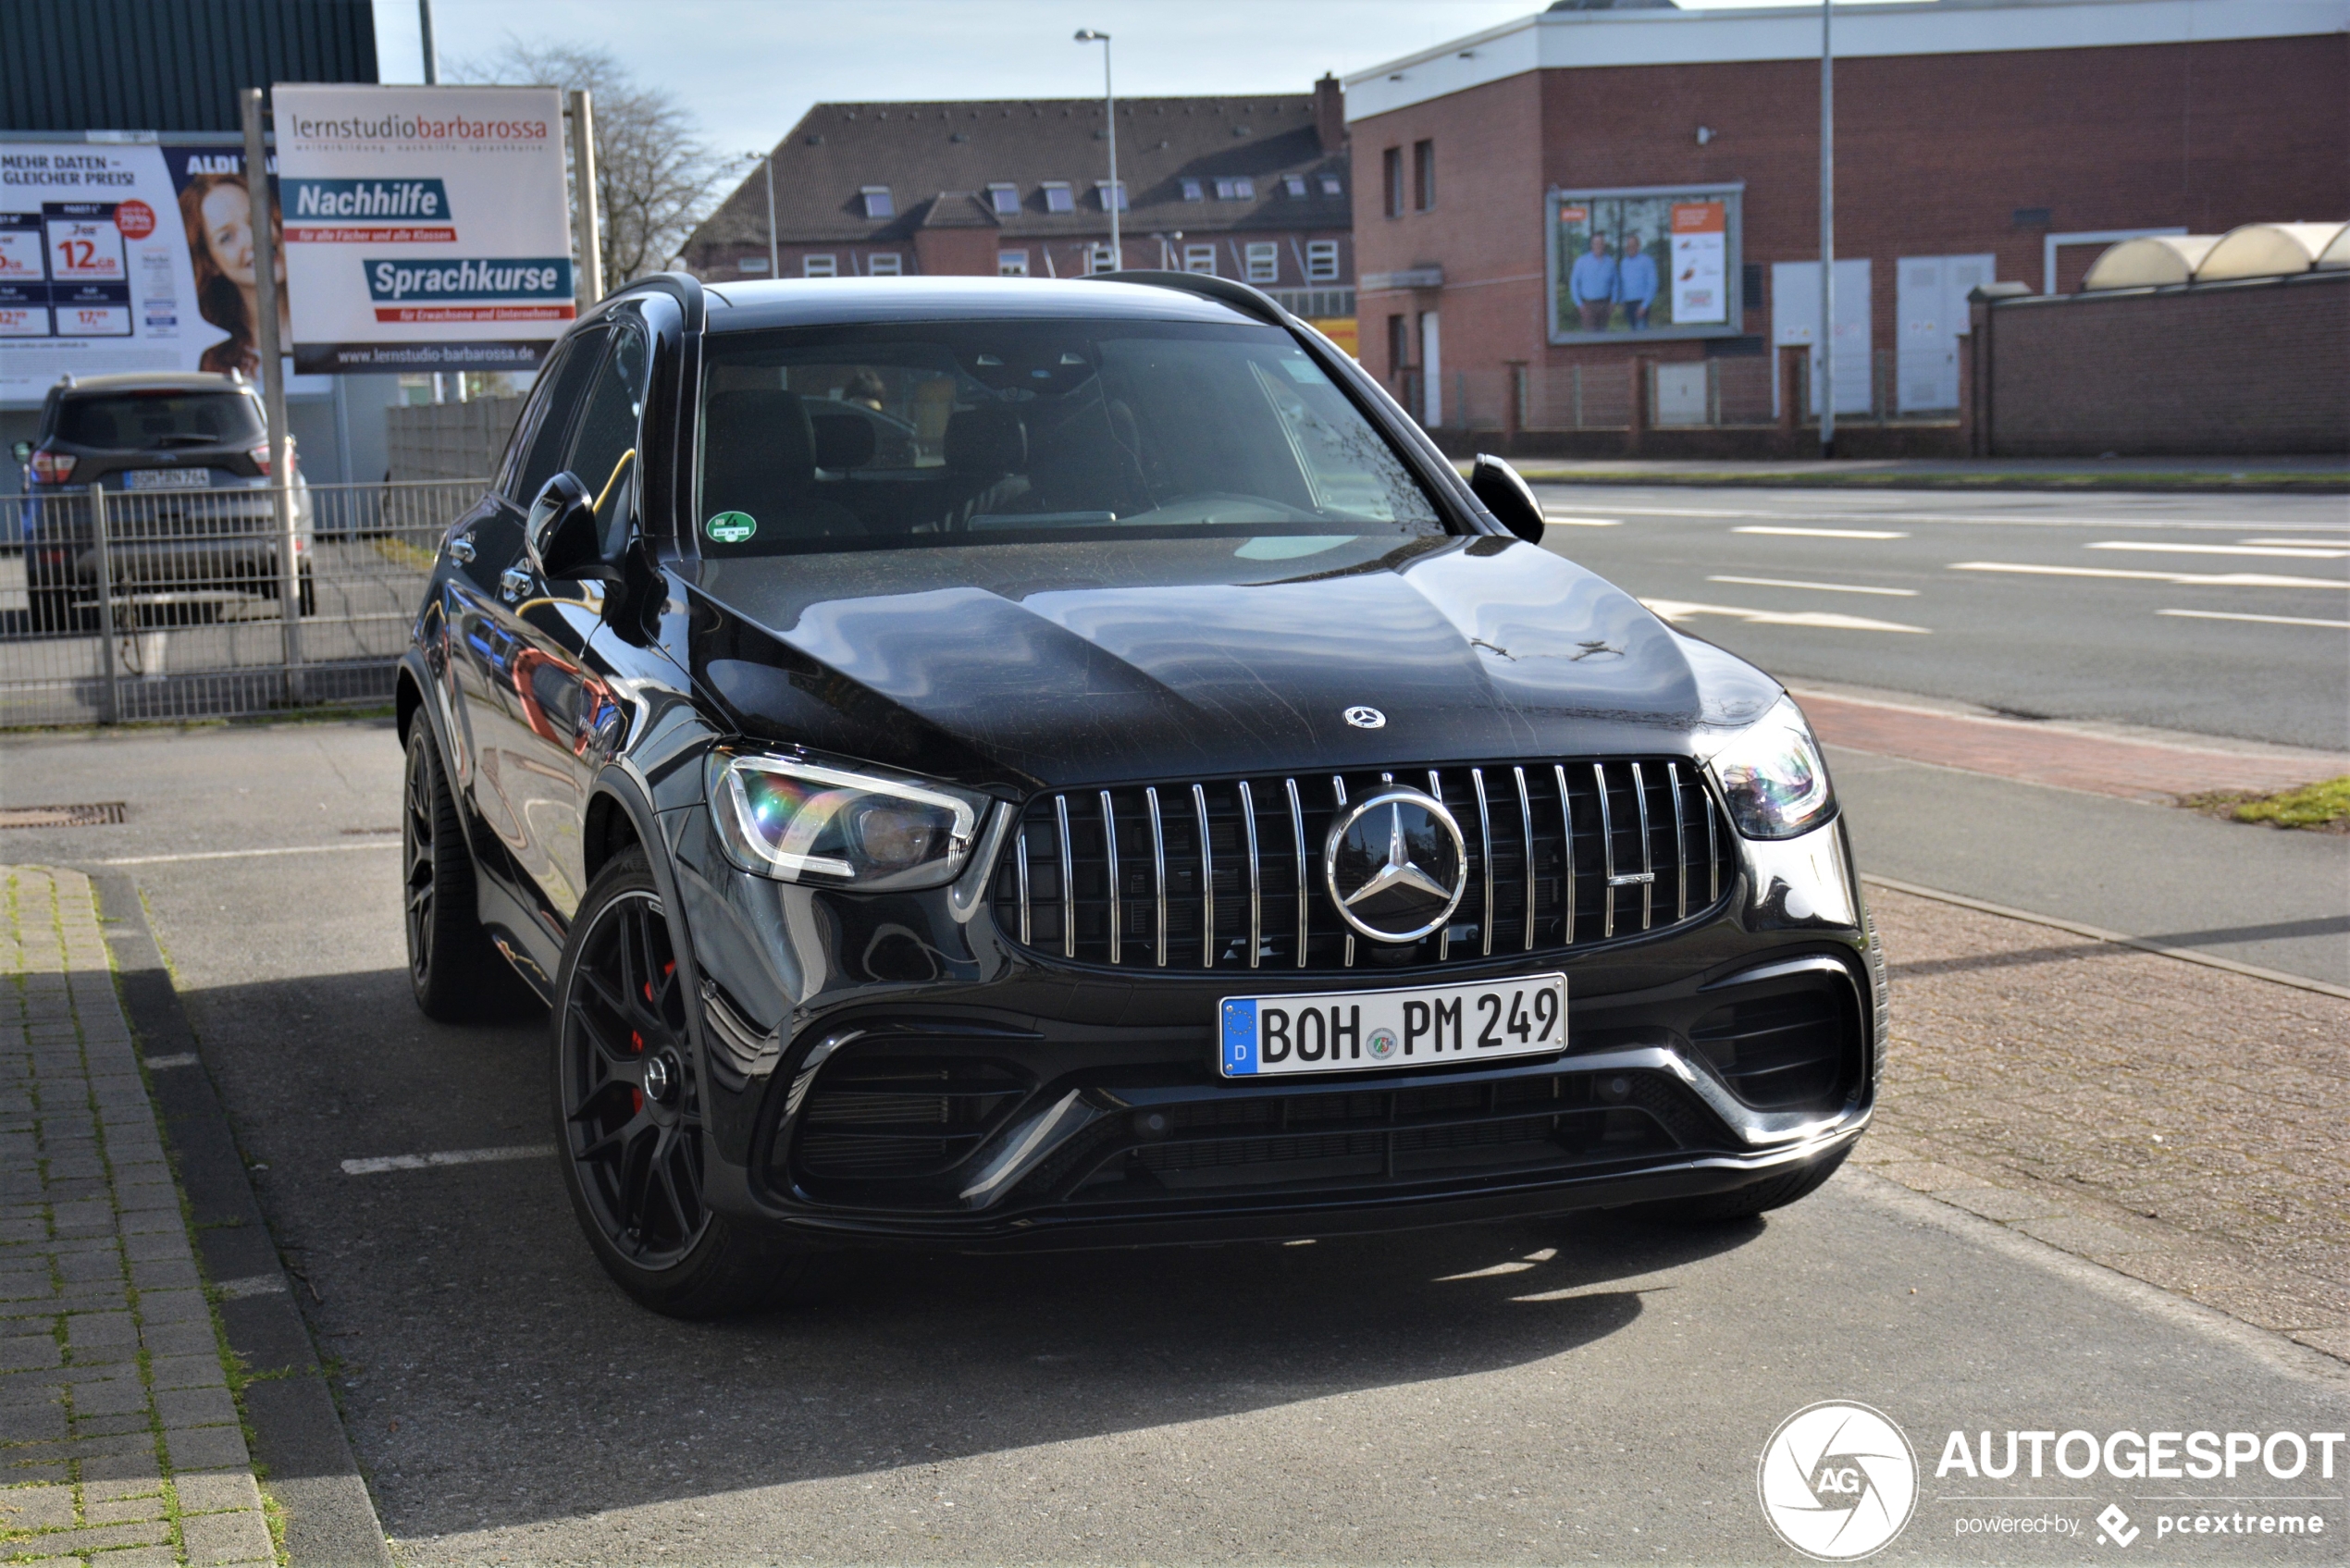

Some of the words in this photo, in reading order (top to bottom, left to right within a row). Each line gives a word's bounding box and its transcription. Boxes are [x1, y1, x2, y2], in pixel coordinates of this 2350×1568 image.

[1, 155, 48, 168] MEHR
[54, 155, 106, 169] DATEN
[187, 154, 240, 175] ALDI
[3, 172, 80, 185] GLEICHER
[85, 172, 135, 185] PREIS!
[297, 182, 439, 216] Nachhilfe
[299, 228, 314, 241] für
[315, 229, 335, 241] alle
[372, 228, 391, 241] und
[393, 228, 411, 241] alle
[414, 228, 451, 241] Klassen
[57, 239, 96, 268] 12
[375, 260, 559, 300] Sprachkurse
[400, 309, 414, 321] für
[417, 308, 474, 320] Erwachsene
[476, 308, 495, 319] und
[497, 307, 560, 319] Unternehmen
[338, 344, 535, 364] www.lernstudio-barbarossa.de
[724, 513, 738, 527] 4
[1261, 1005, 1360, 1063] BOH
[1403, 996, 1462, 1056] PM
[1478, 987, 1559, 1047] 249
[1234, 1044, 1247, 1061] D
